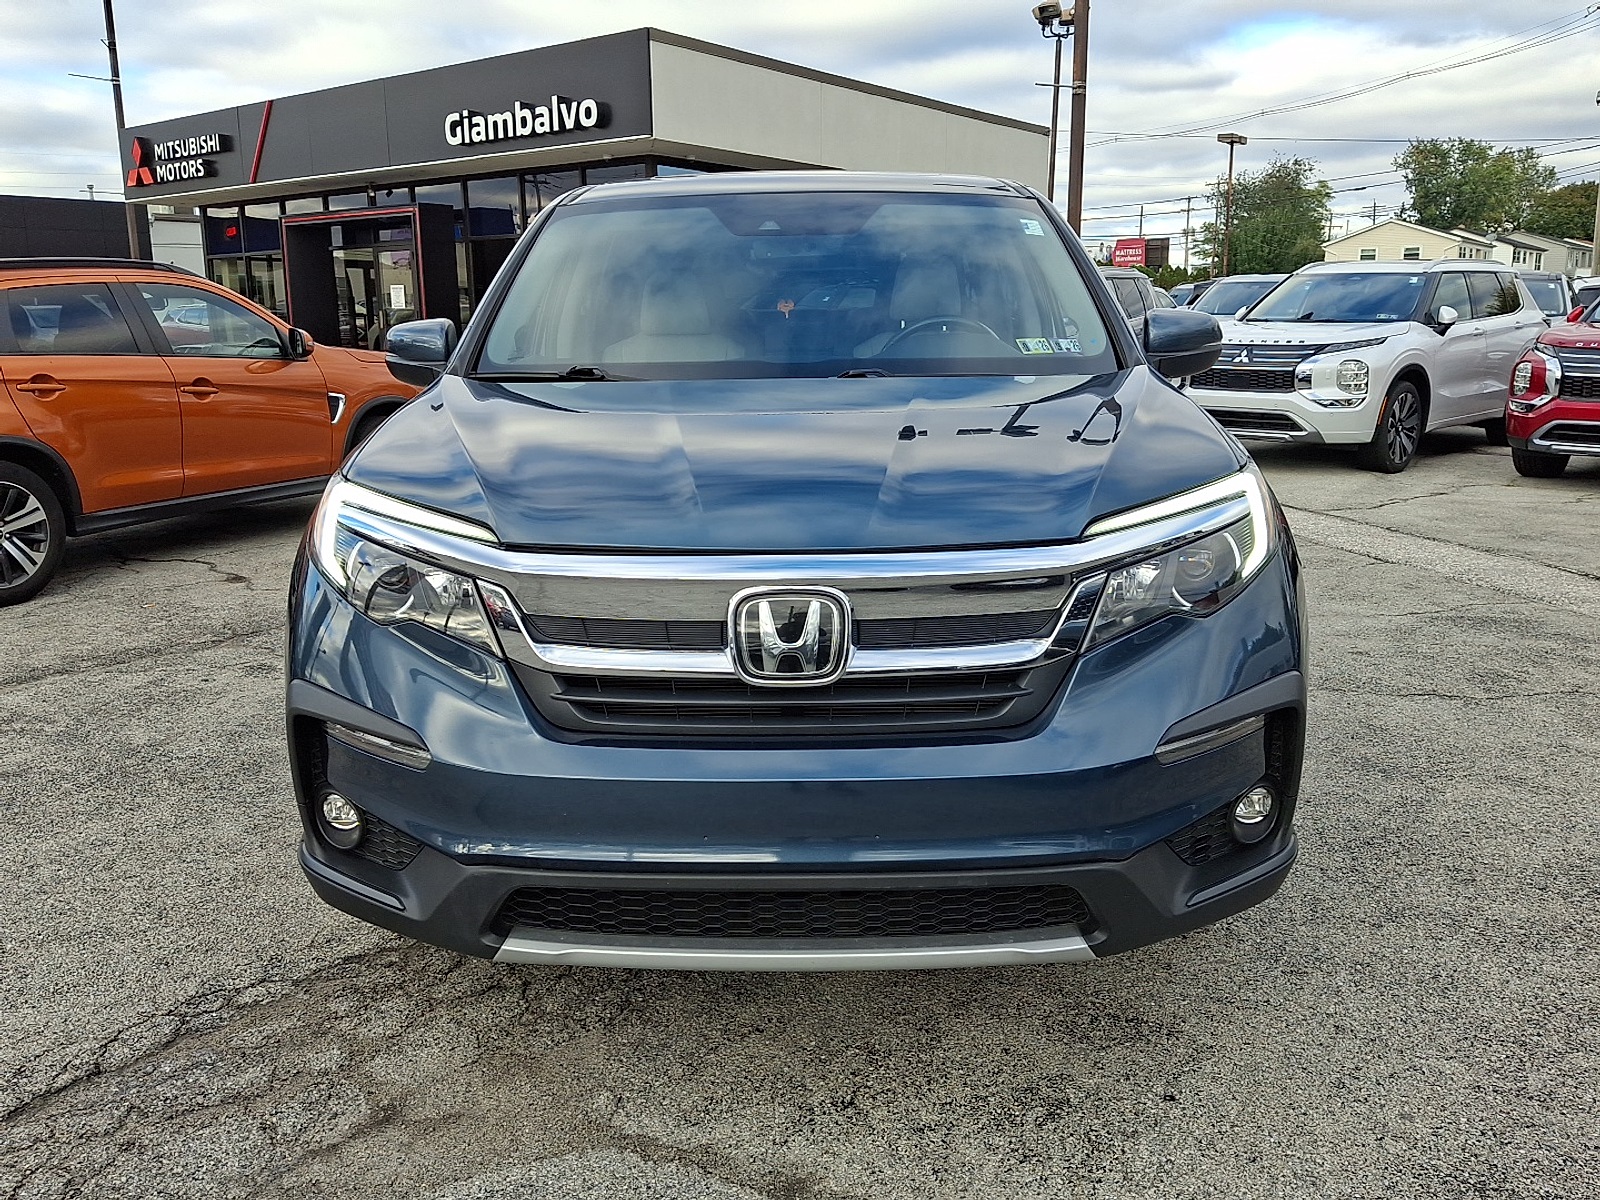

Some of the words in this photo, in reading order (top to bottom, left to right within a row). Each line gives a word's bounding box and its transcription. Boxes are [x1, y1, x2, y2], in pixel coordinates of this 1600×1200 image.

[444, 94, 598, 146] Giambalvo
[154, 133, 220, 161] MITSUBISHI
[156, 158, 204, 182] MOTORS
[1115, 248, 1142, 256] MATTRESS
